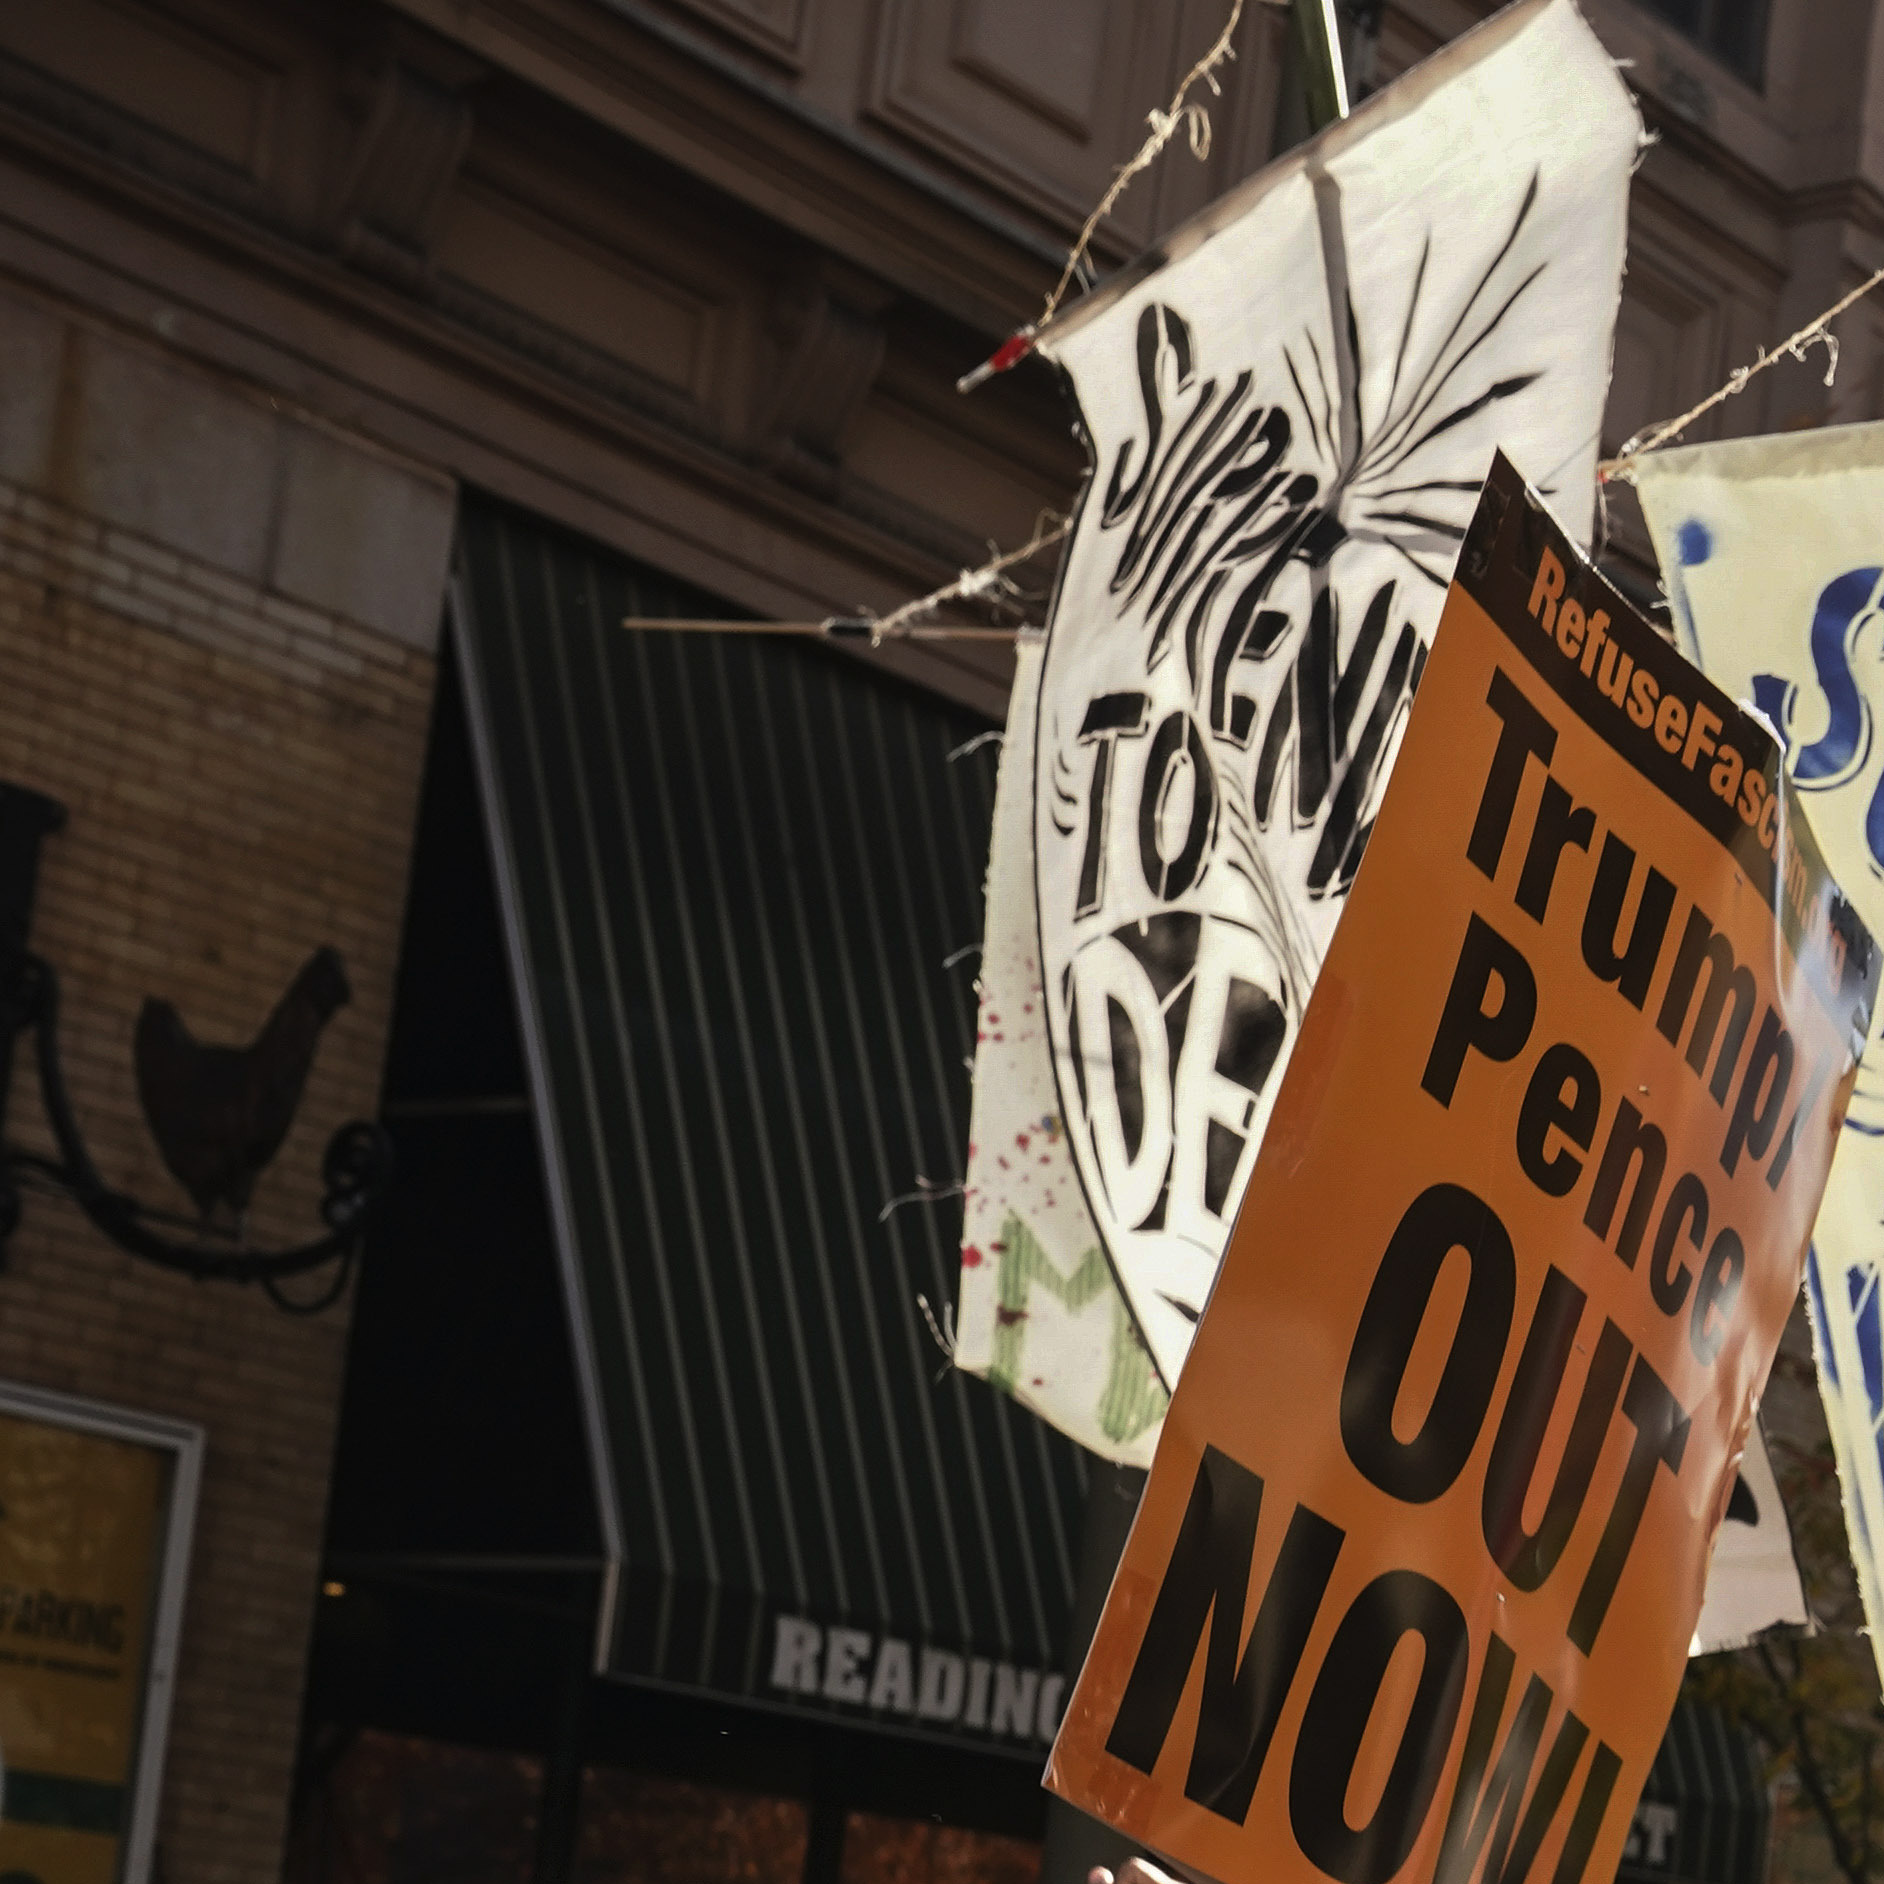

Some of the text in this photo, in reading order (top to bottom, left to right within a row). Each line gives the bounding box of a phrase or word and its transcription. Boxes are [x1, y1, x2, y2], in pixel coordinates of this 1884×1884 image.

[1074, 692, 1222, 923] TO
[1421, 912, 1747, 1367] Pence
[1340, 1181, 1692, 1657] OUT
